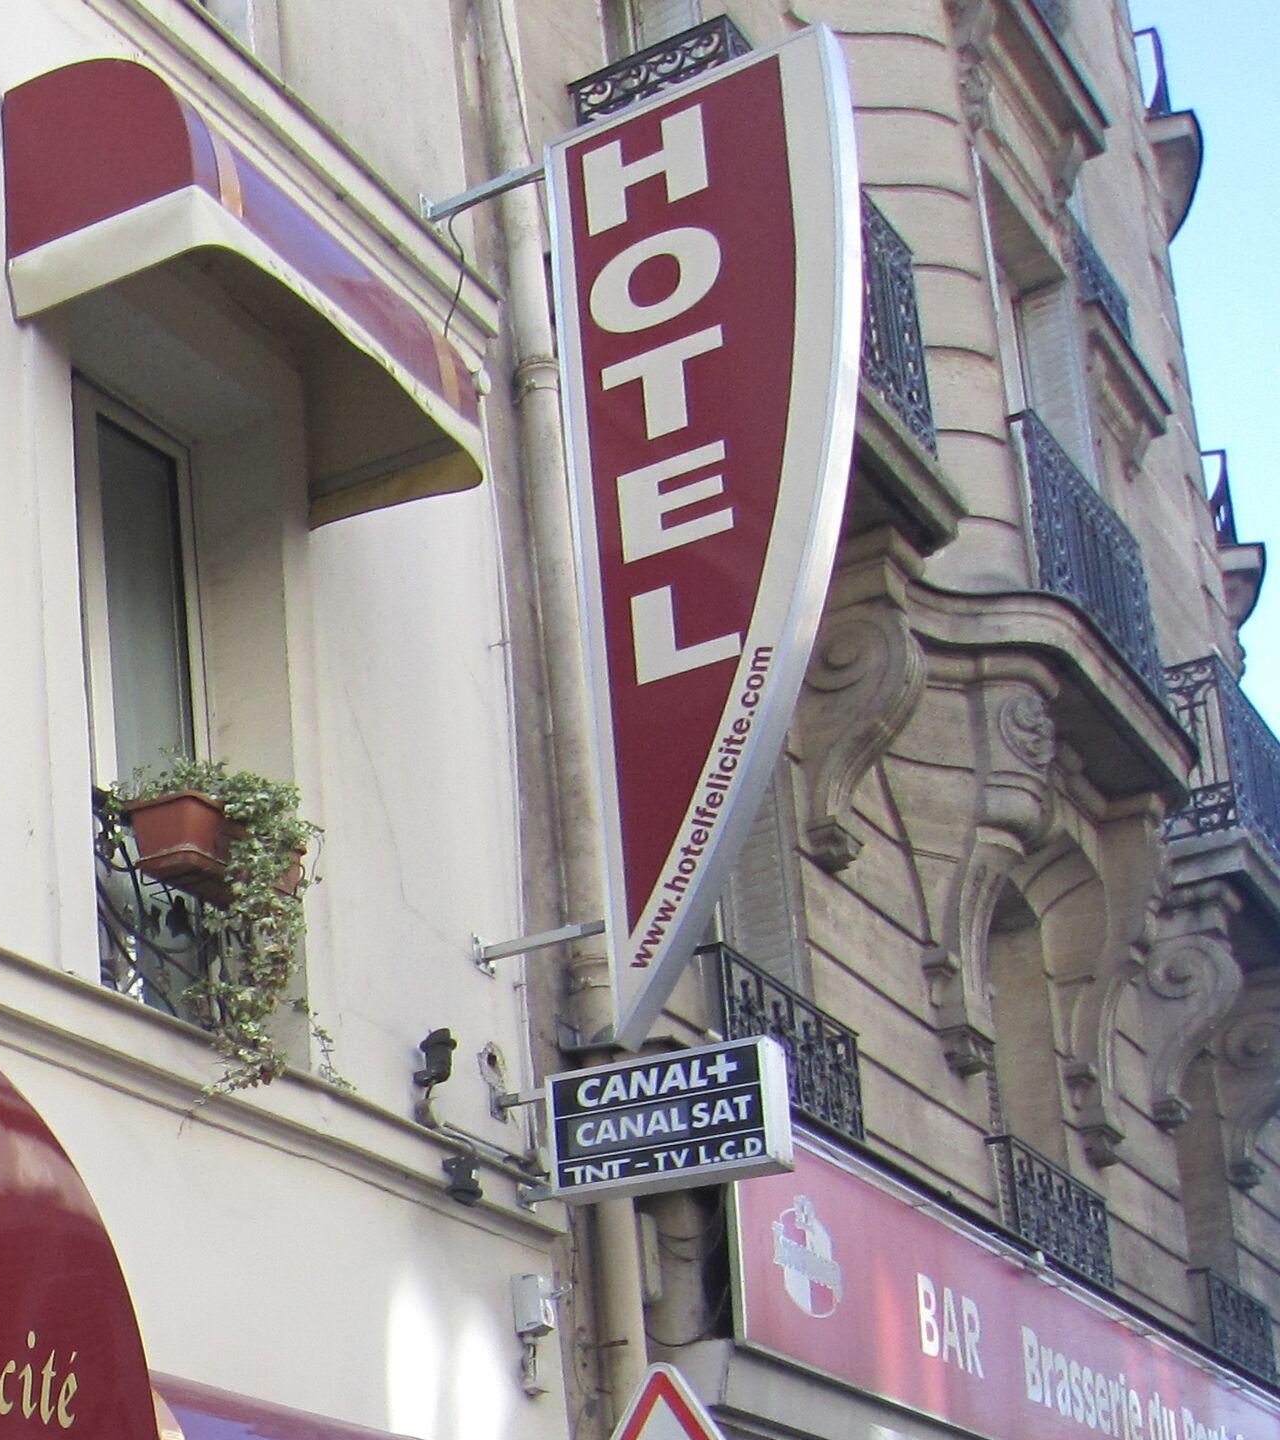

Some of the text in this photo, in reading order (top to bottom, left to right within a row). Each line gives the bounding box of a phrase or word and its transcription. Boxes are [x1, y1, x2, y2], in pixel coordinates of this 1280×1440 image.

[582, 103, 742, 686] HOTEL
[629, 645, 774, 970] www.hotelfelicite.com
[576, 1053, 738, 1108] CANAL+
[563, 1157, 632, 1186] TNT
[652, 1147, 690, 1172] TV
[698, 1136, 763, 1166] L.C.D
[915, 1271, 986, 1380] BAR
